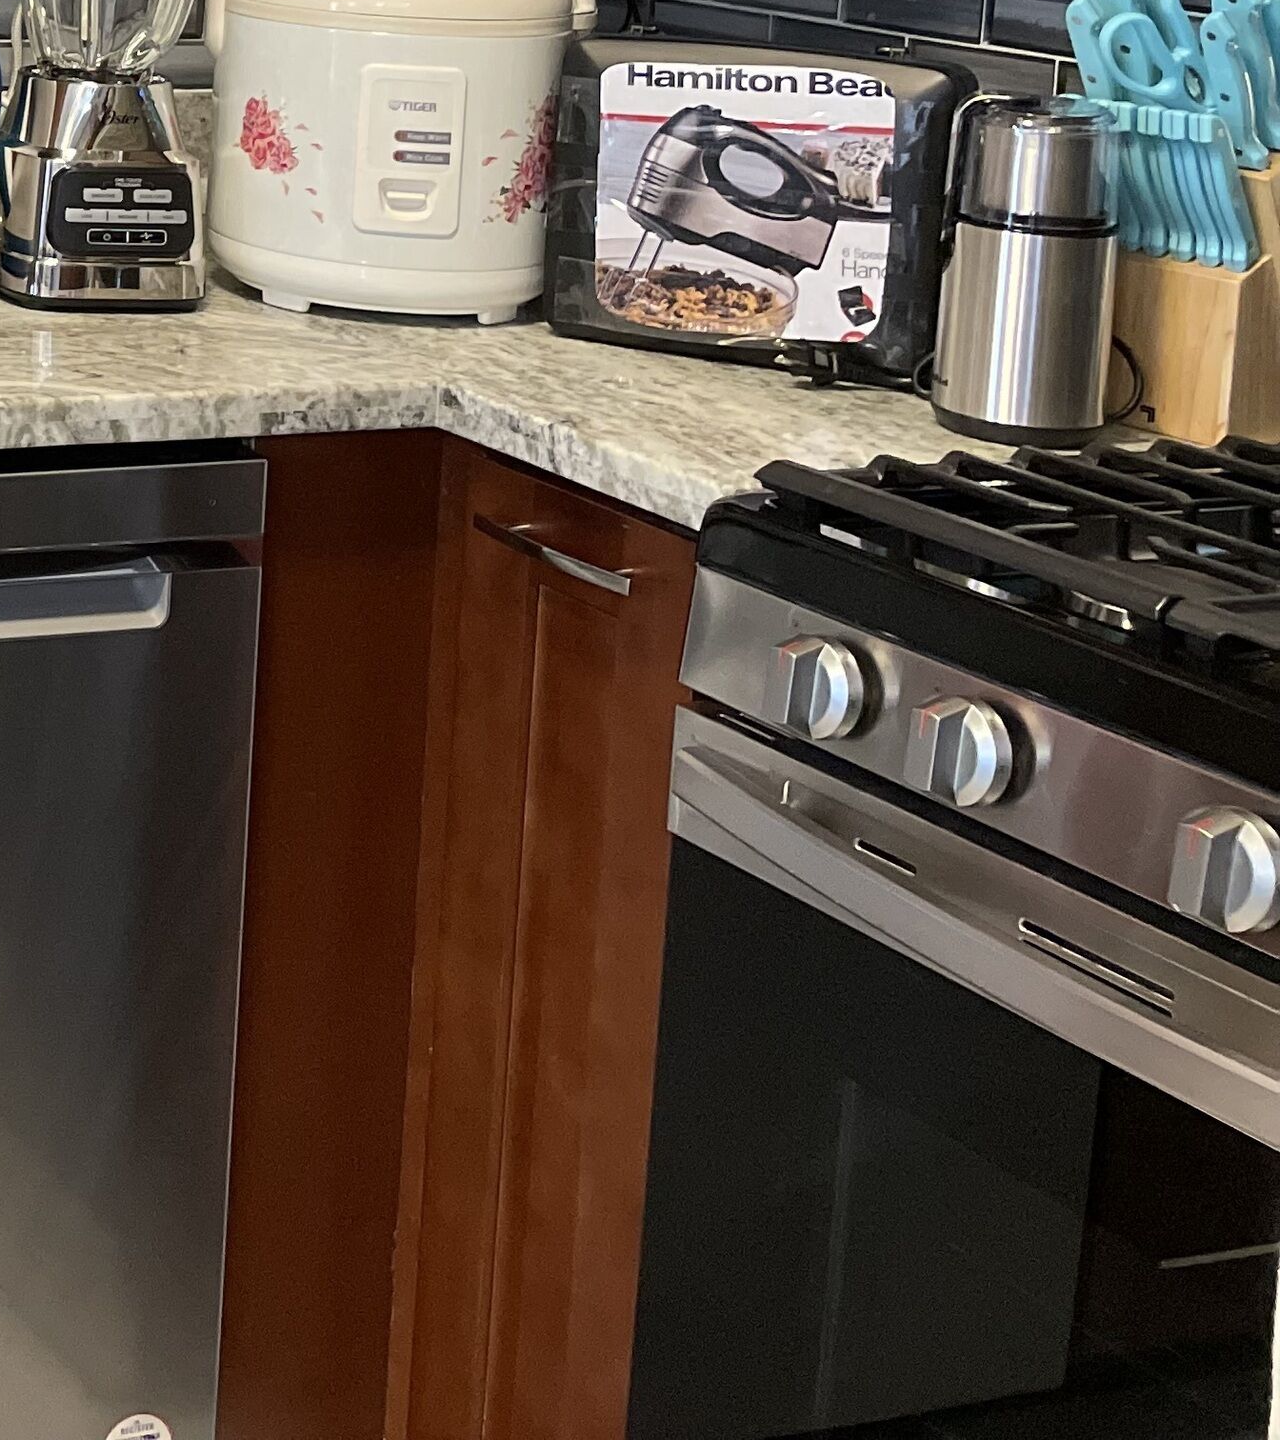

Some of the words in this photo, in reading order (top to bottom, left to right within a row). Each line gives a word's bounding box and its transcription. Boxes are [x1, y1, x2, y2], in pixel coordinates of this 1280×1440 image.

[627, 63, 798, 93] Hamilton
[401, 101, 437, 112] TIGER
[853, 248, 888, 259] Spee
